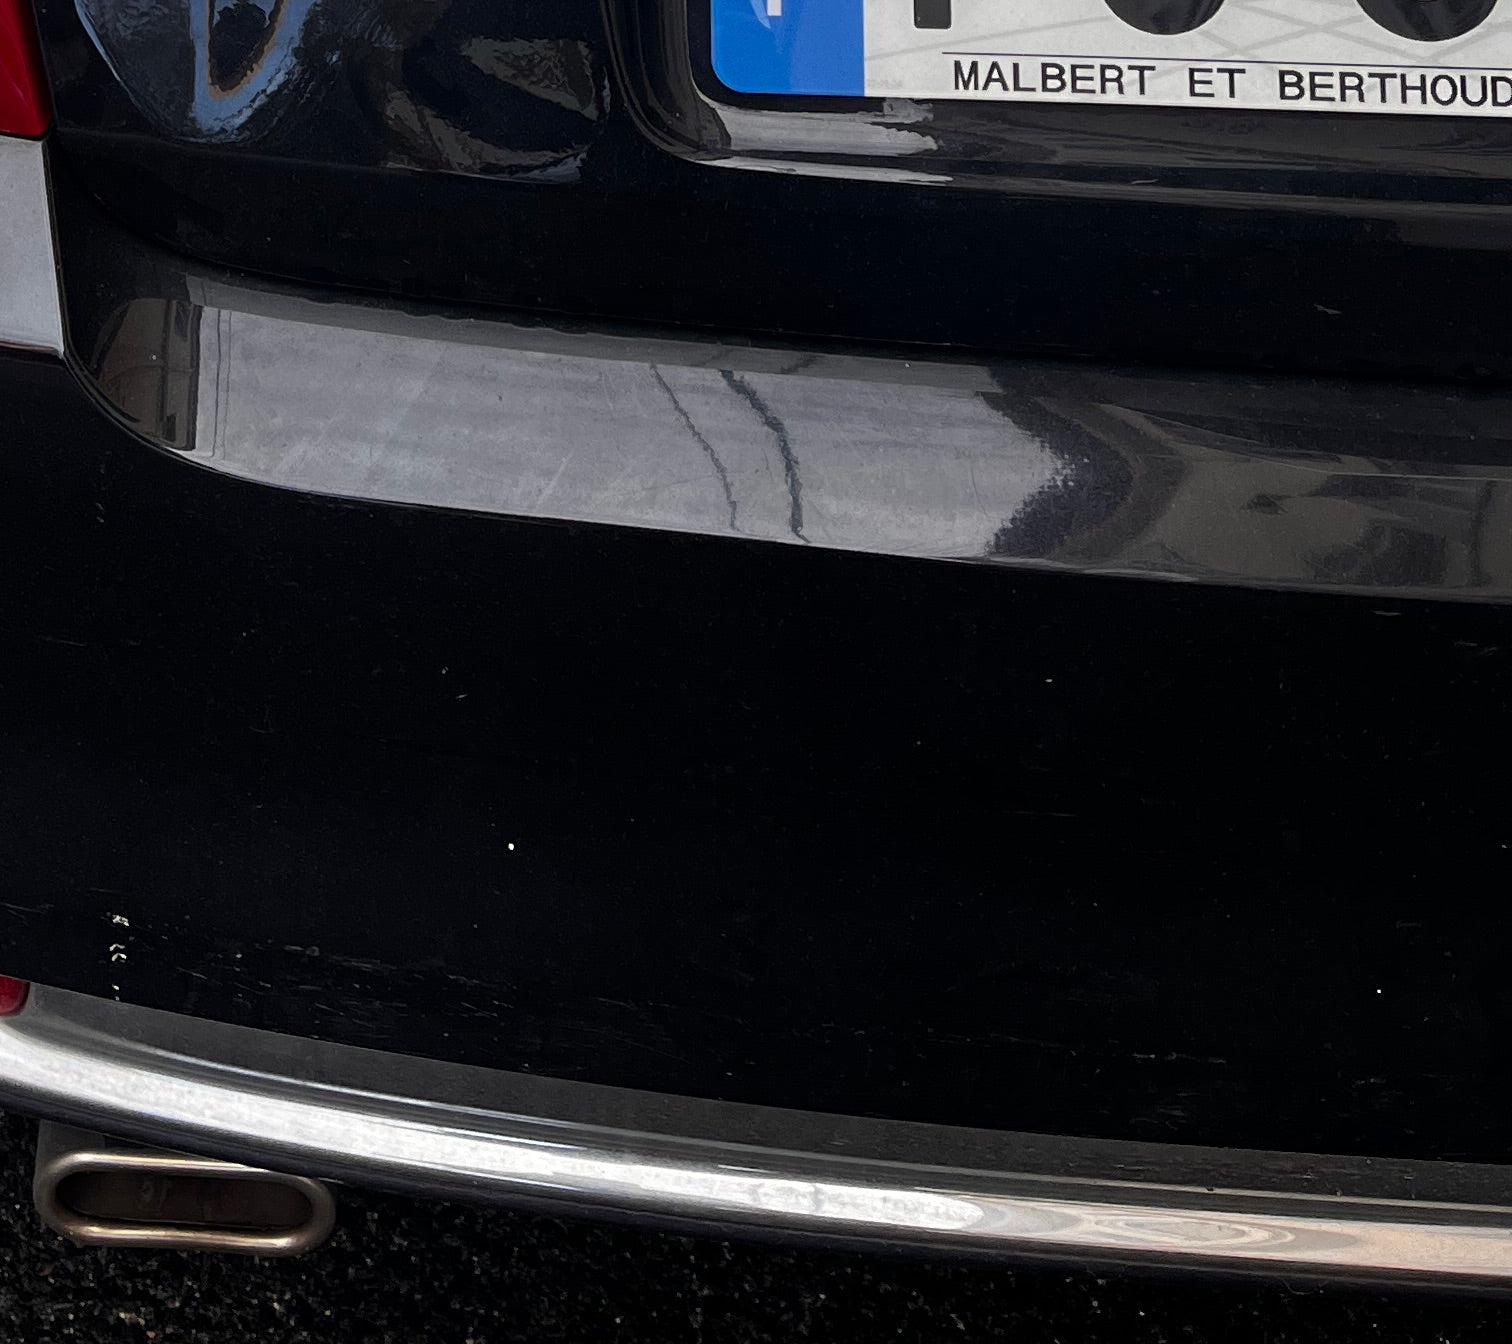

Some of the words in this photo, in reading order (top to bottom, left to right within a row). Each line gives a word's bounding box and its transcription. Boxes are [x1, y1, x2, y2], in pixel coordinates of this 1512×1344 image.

[953, 60, 1156, 97] MALBERT
[1189, 67, 1246, 100] ET
[1278, 70, 1512, 108] BERTHOUD
